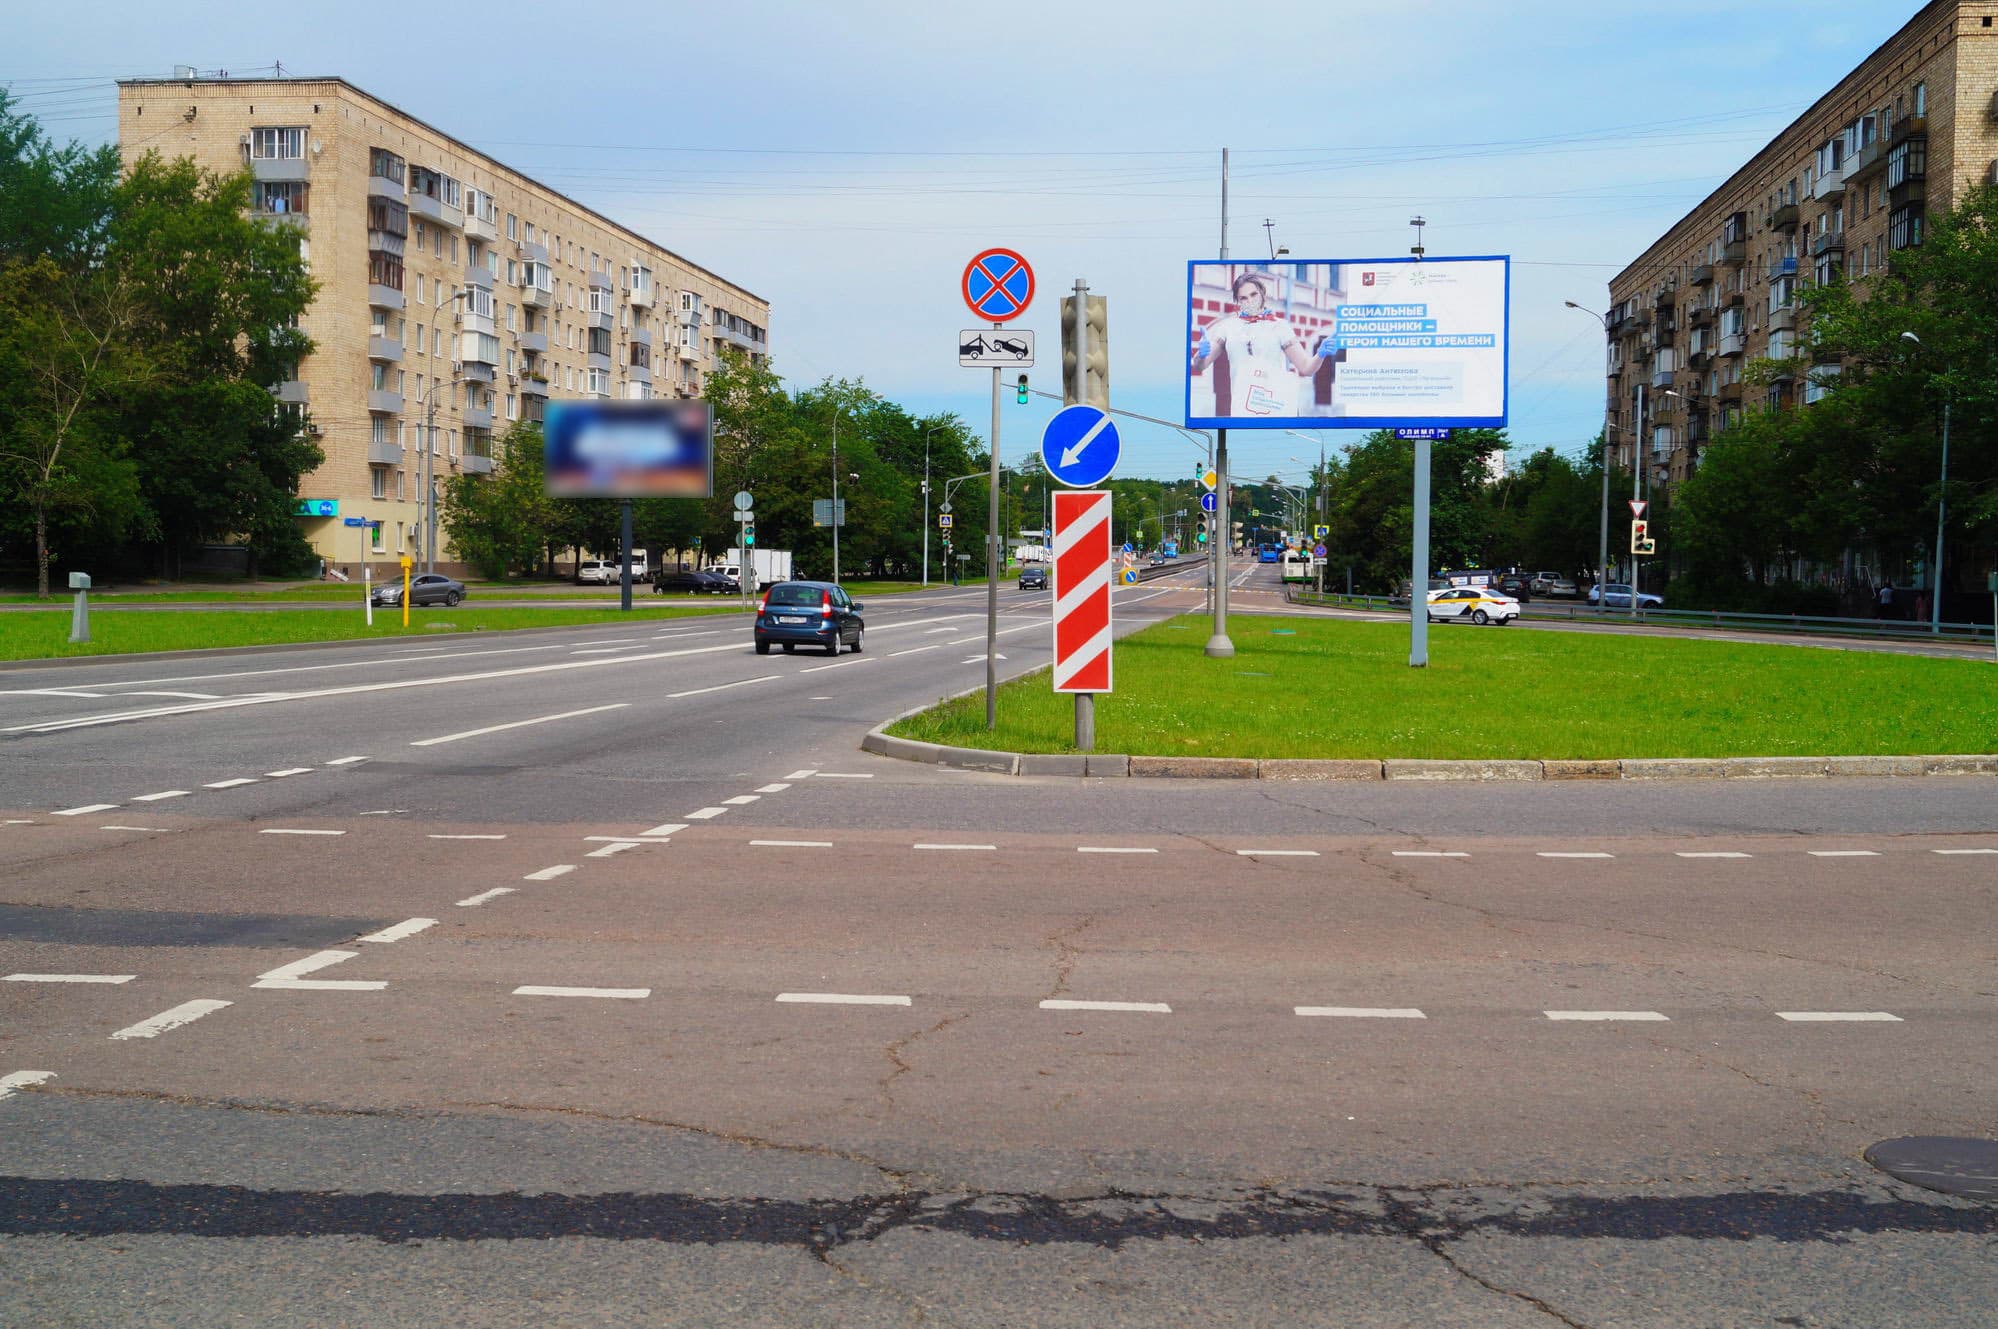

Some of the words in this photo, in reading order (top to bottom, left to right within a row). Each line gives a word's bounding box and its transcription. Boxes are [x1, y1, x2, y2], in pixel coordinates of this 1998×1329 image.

[1341, 306, 1424, 318] СОЦИАЛЬНЫЕ
[1340, 322, 1422, 332] ПОМОЩНИКИ
[1341, 337, 1378, 346] ГЕРОИ
[1382, 336, 1432, 346] НАШЕГО
[1435, 335, 1491, 345] ВРЕМЕНИ
